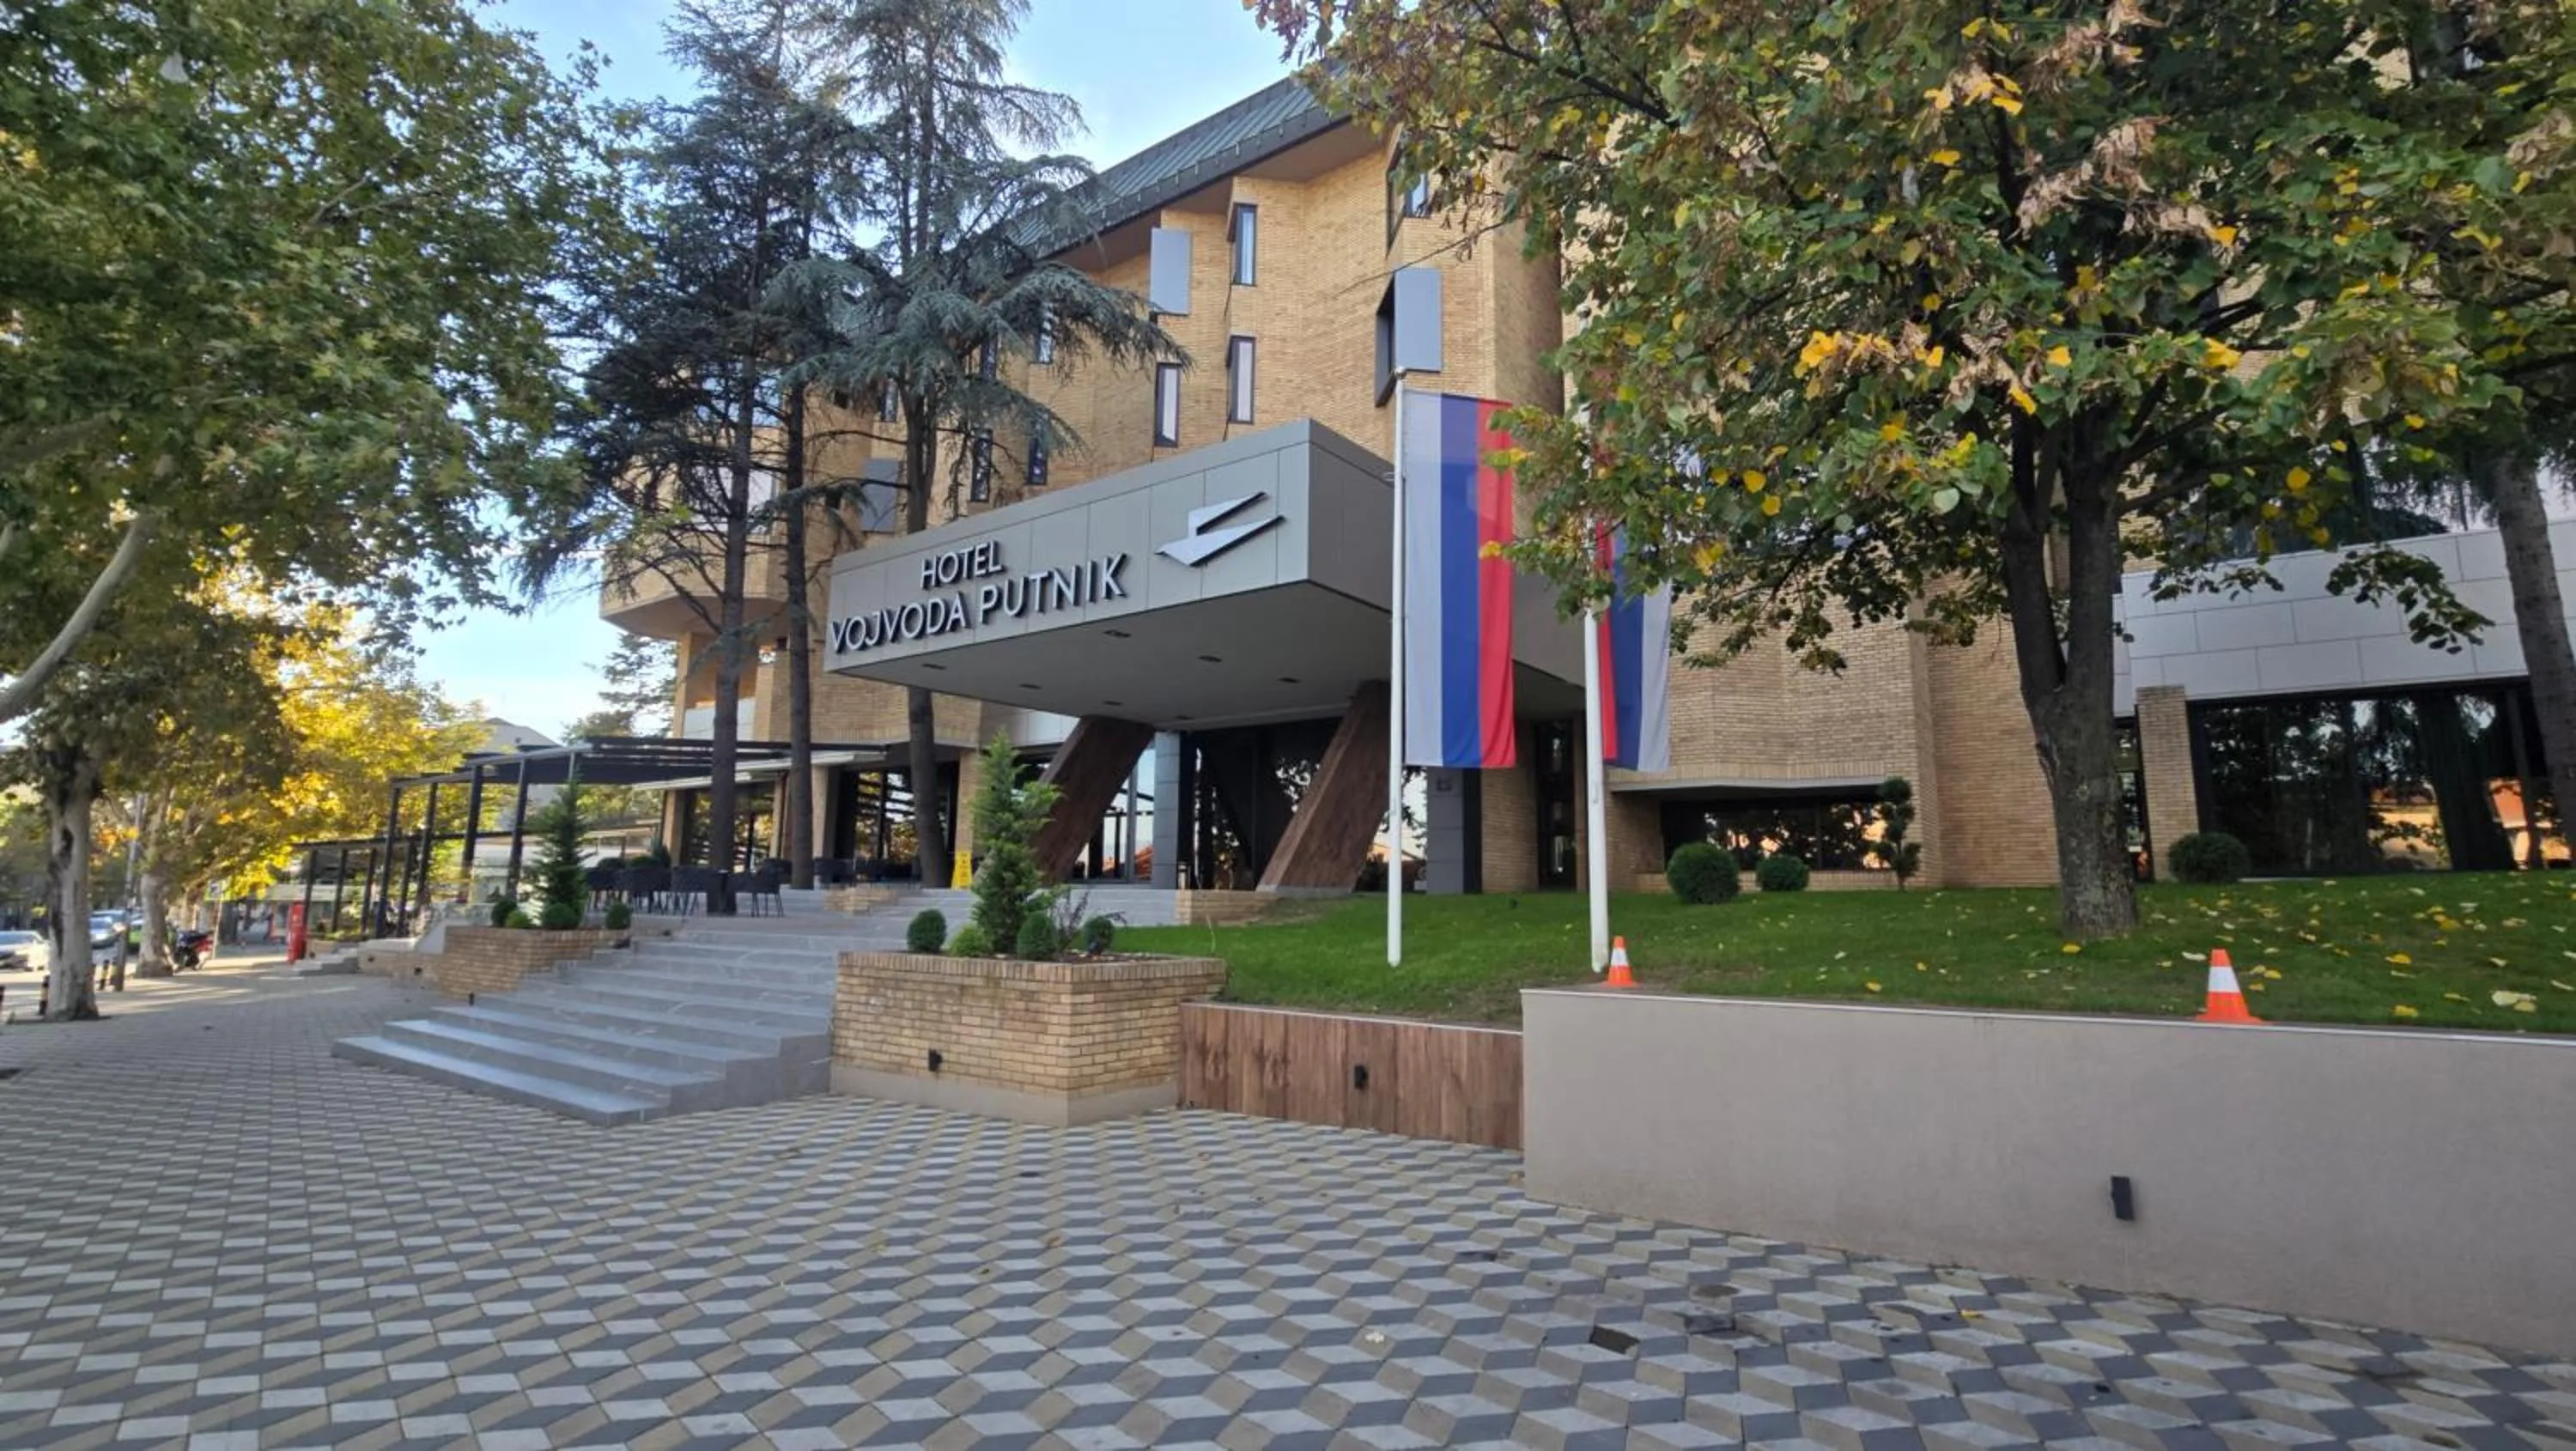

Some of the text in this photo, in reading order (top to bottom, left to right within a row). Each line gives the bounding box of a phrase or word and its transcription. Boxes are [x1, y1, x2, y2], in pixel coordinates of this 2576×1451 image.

[920, 540, 1004, 589] HOTEL
[831, 553, 1126, 651] VOJVODA PUTNIK
